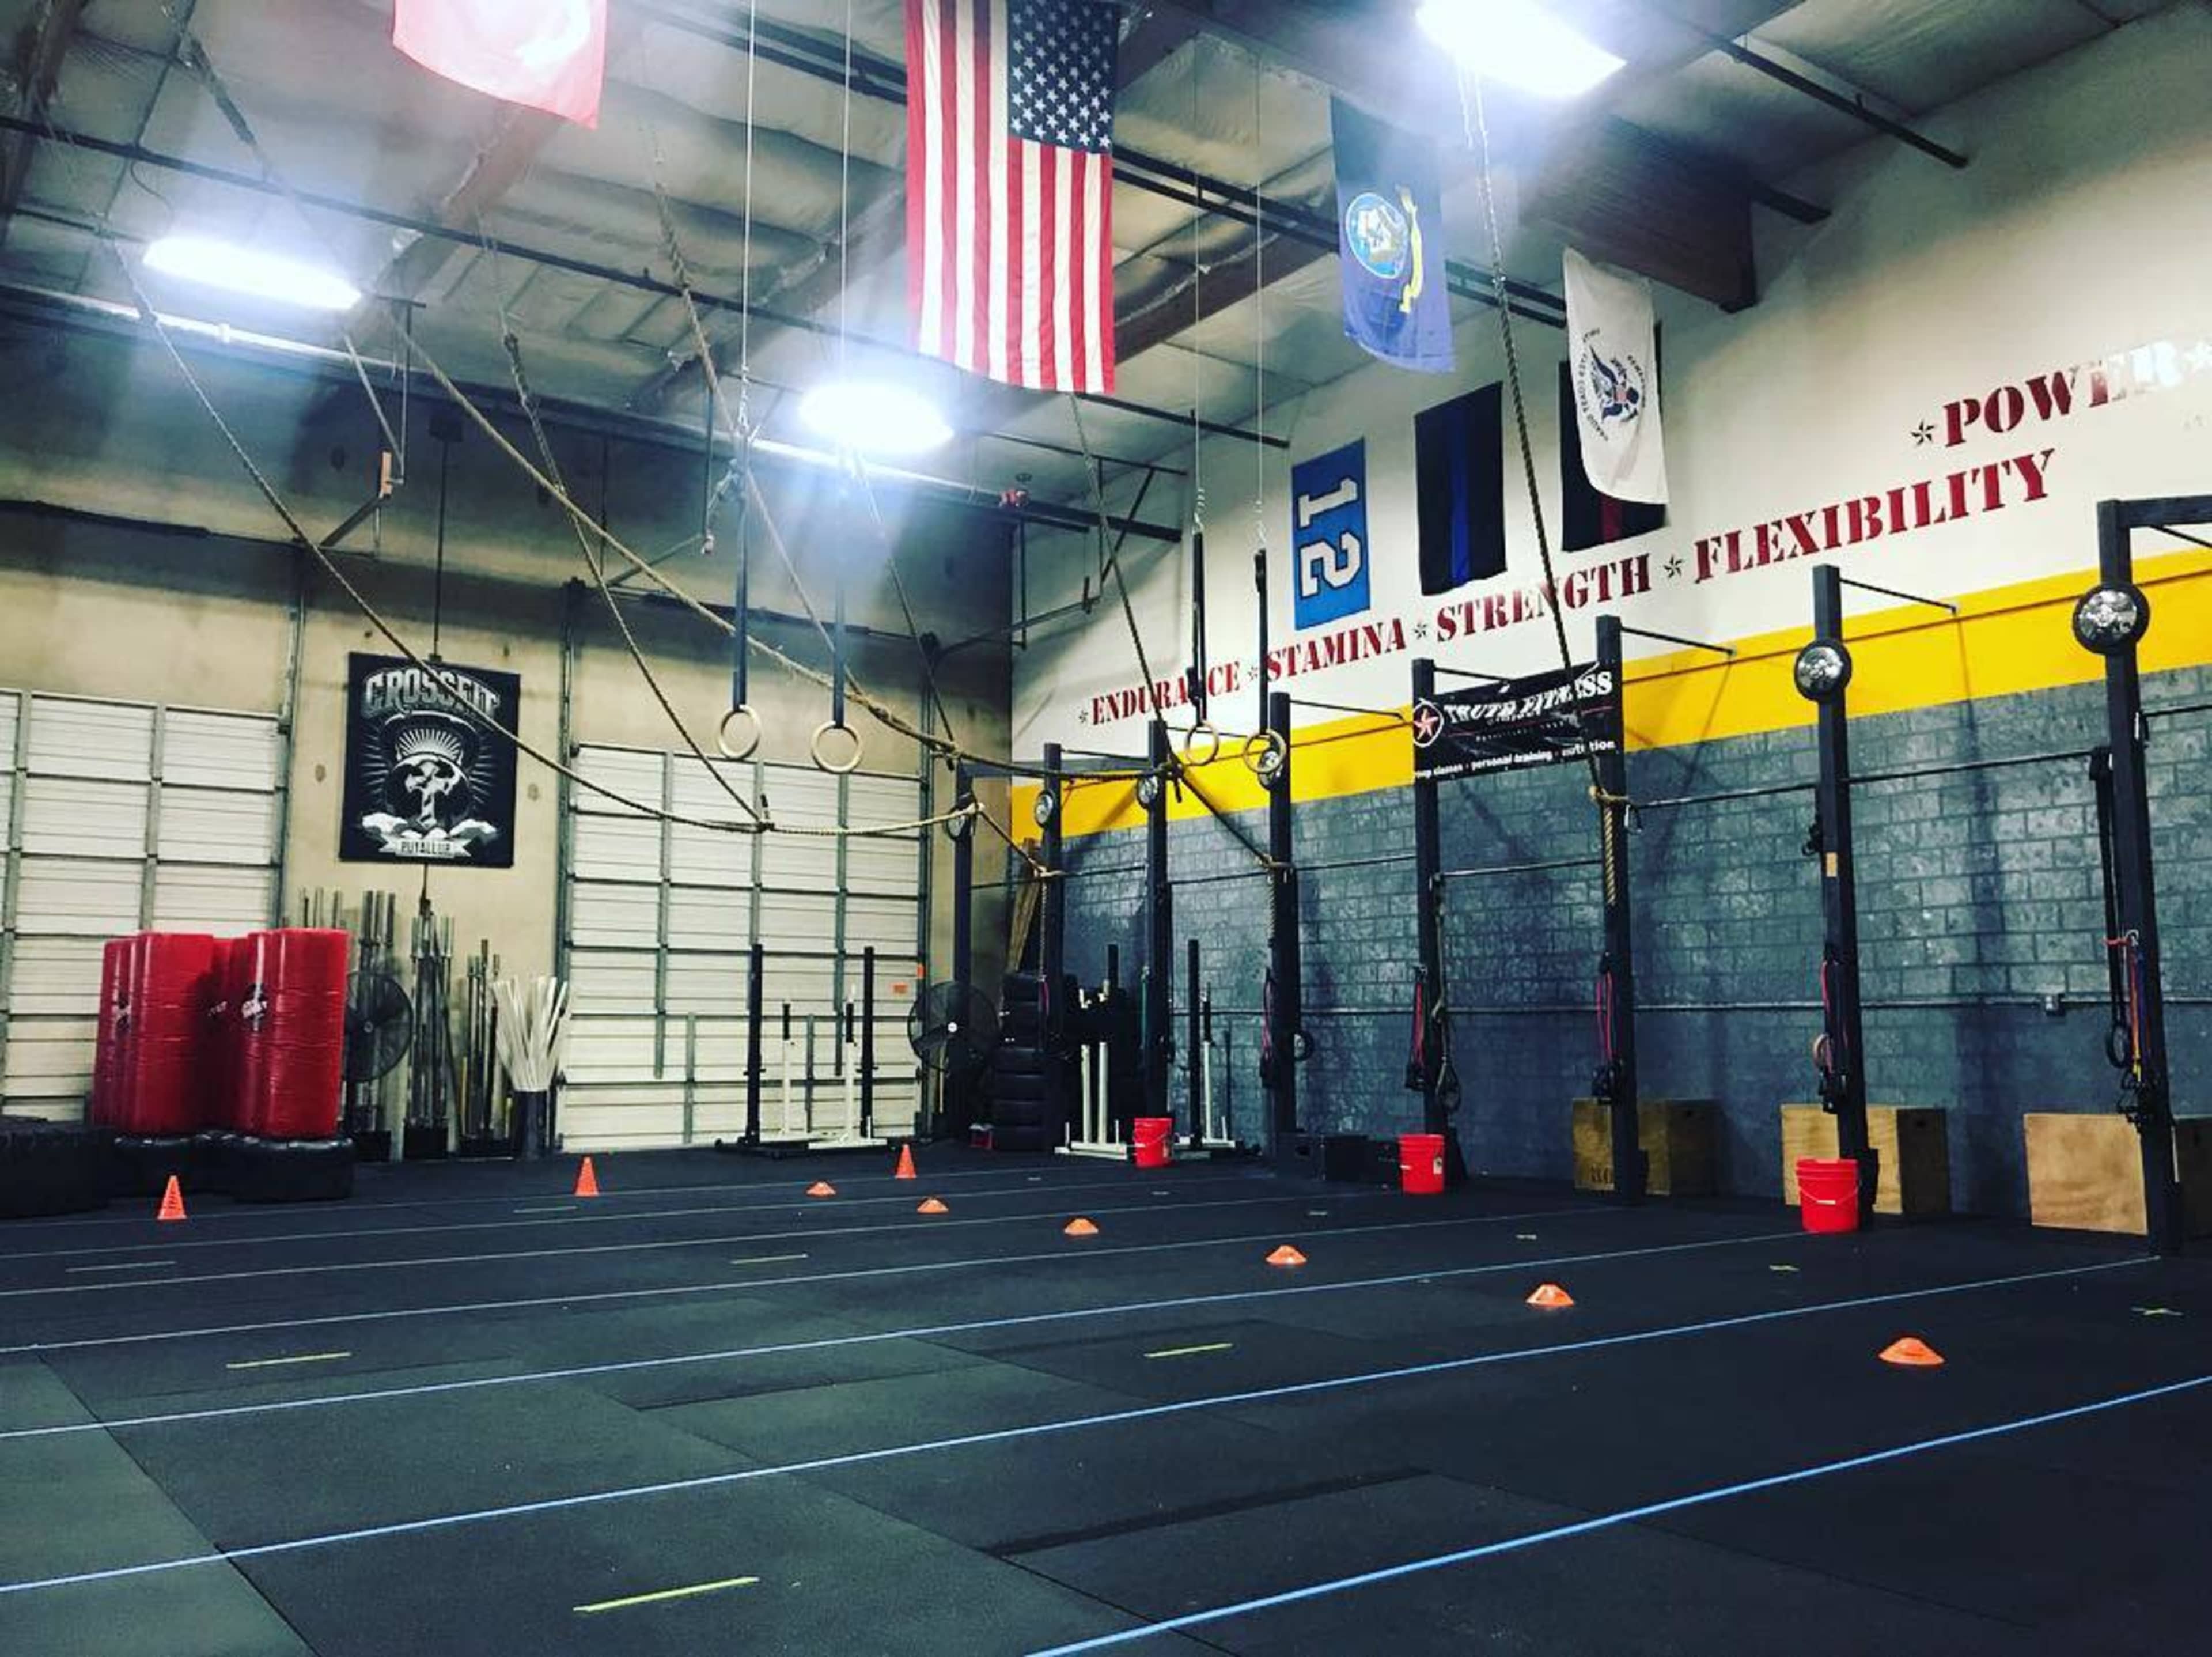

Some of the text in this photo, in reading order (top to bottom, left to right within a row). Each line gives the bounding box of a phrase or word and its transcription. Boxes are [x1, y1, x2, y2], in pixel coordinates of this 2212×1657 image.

[1092, 448, 2055, 725] ENDURACE STAMINA STRENGTH FLEXIBILITY
[1297, 476, 1362, 599] 12
